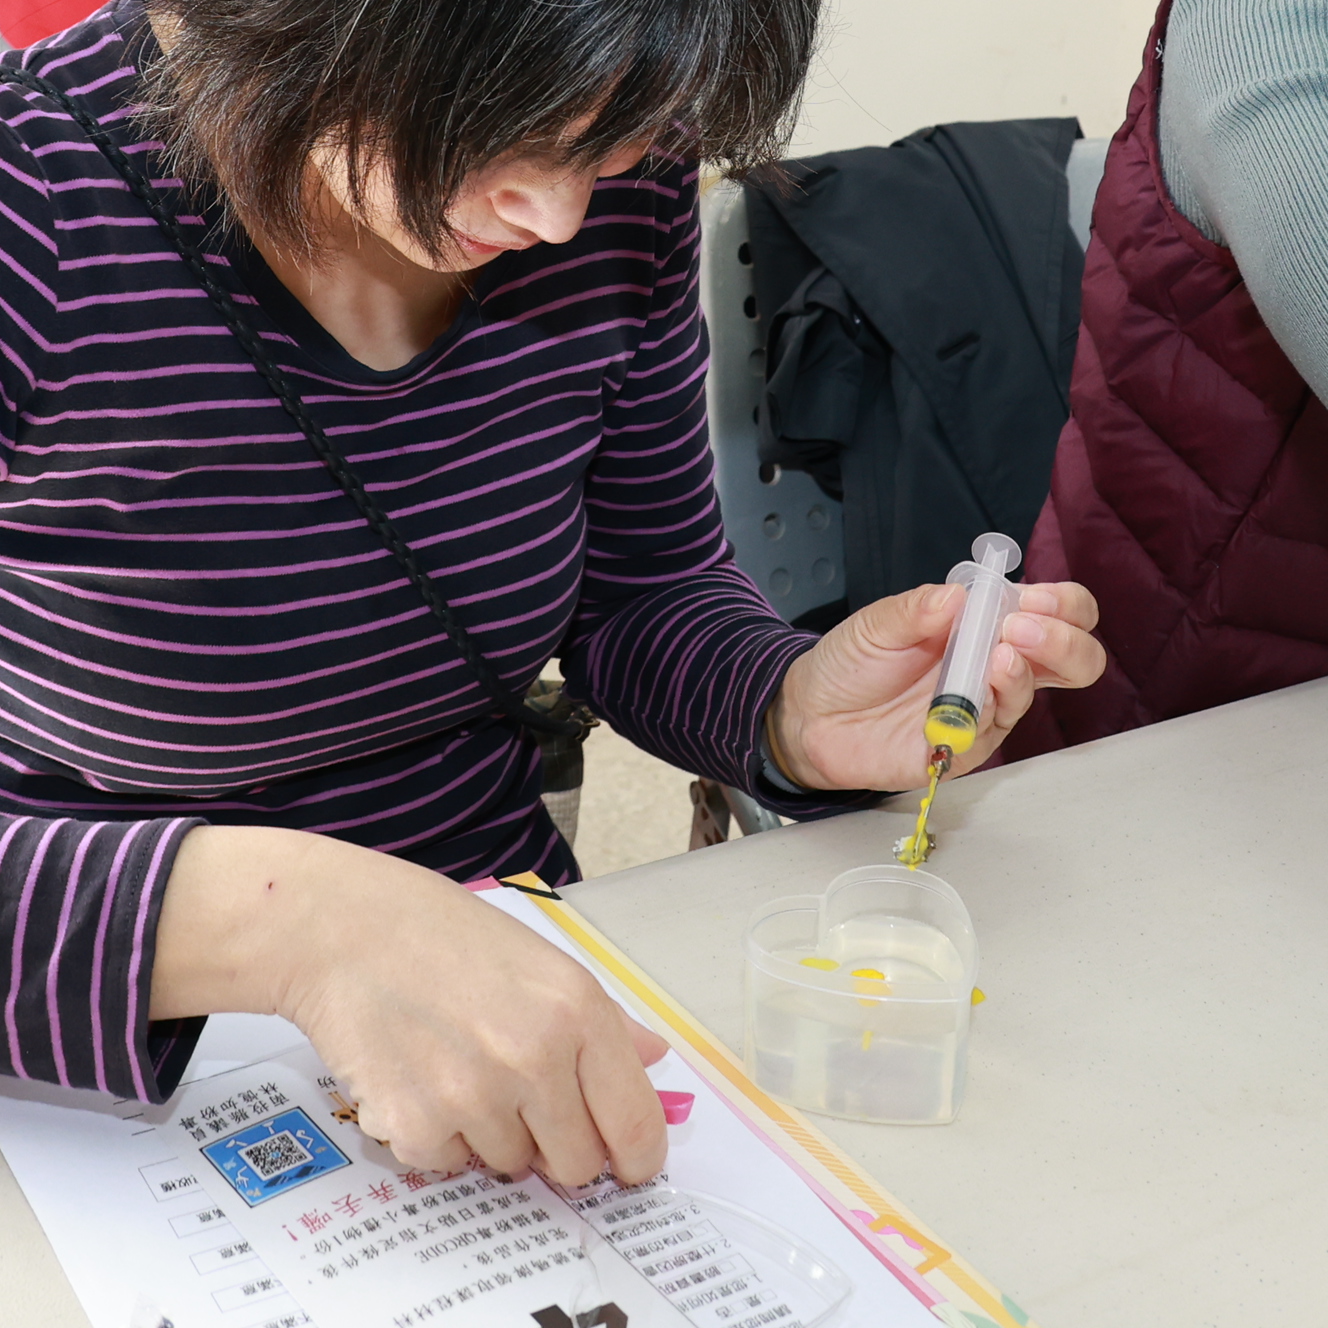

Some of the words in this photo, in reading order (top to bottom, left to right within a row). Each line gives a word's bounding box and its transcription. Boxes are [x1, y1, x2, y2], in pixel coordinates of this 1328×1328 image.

[188, 1091, 291, 1143] 南投縣議員
